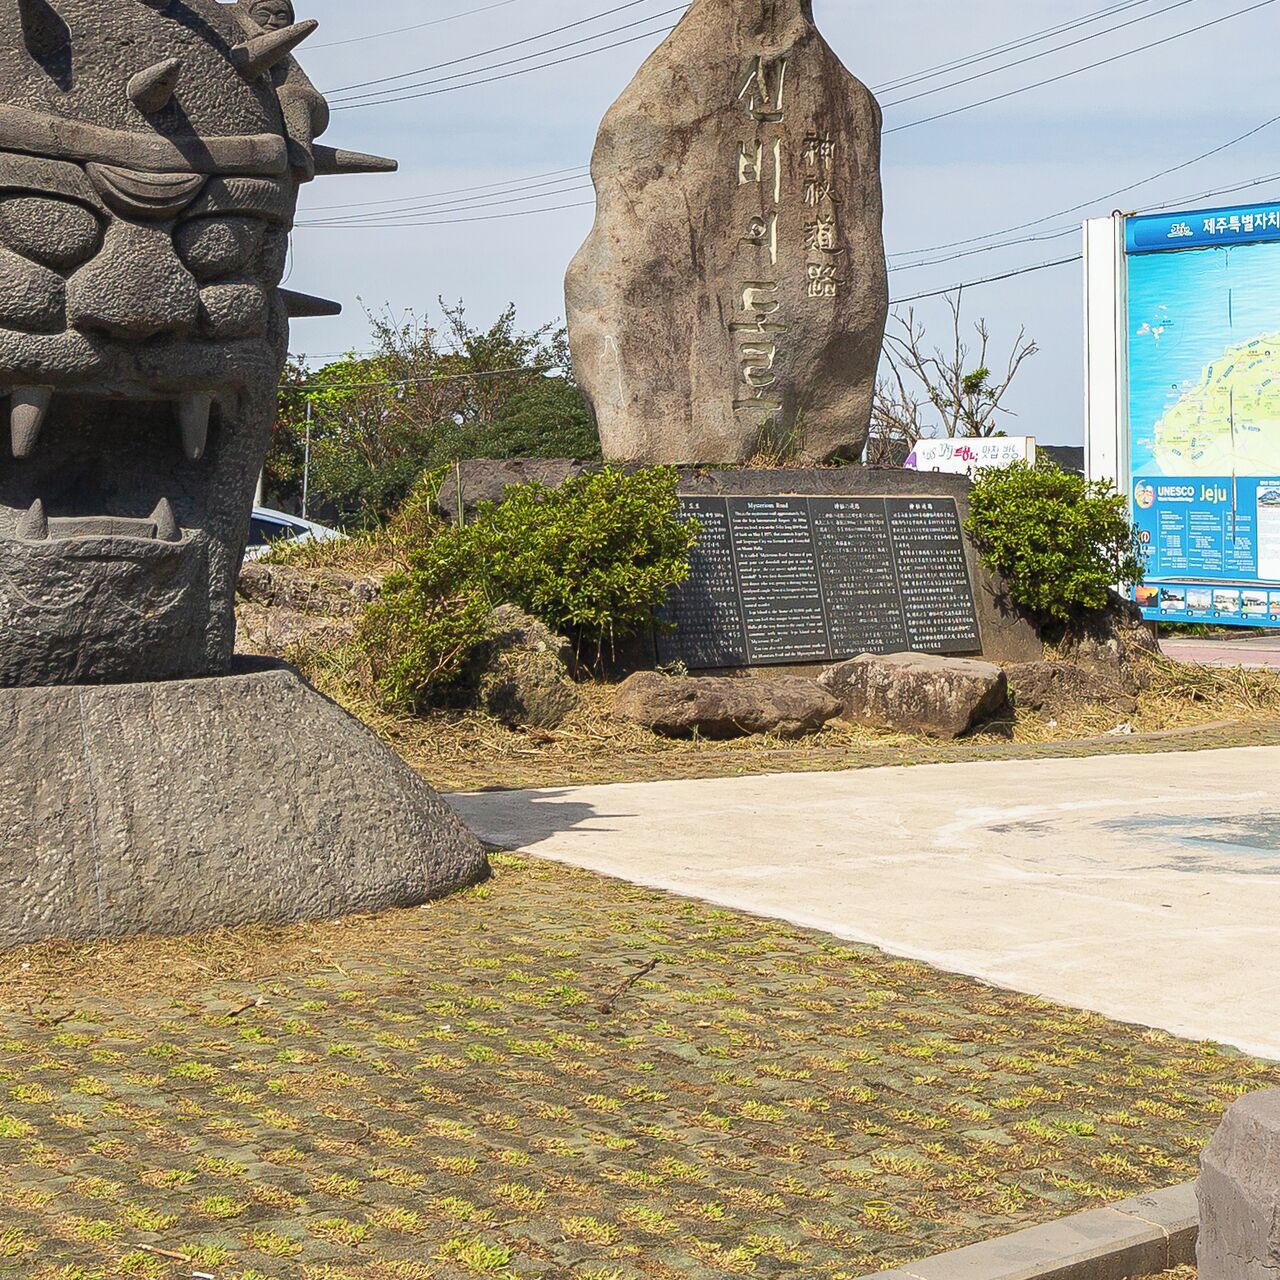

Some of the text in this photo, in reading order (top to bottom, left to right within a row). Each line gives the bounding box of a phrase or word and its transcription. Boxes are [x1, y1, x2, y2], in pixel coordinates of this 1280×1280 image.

[728, 56, 787, 411] 신비의 도로
[1157, 486, 1195, 497] UNESCO
[1199, 484, 1227, 504] Jeju
[747, 502, 774, 510] Mysterious
